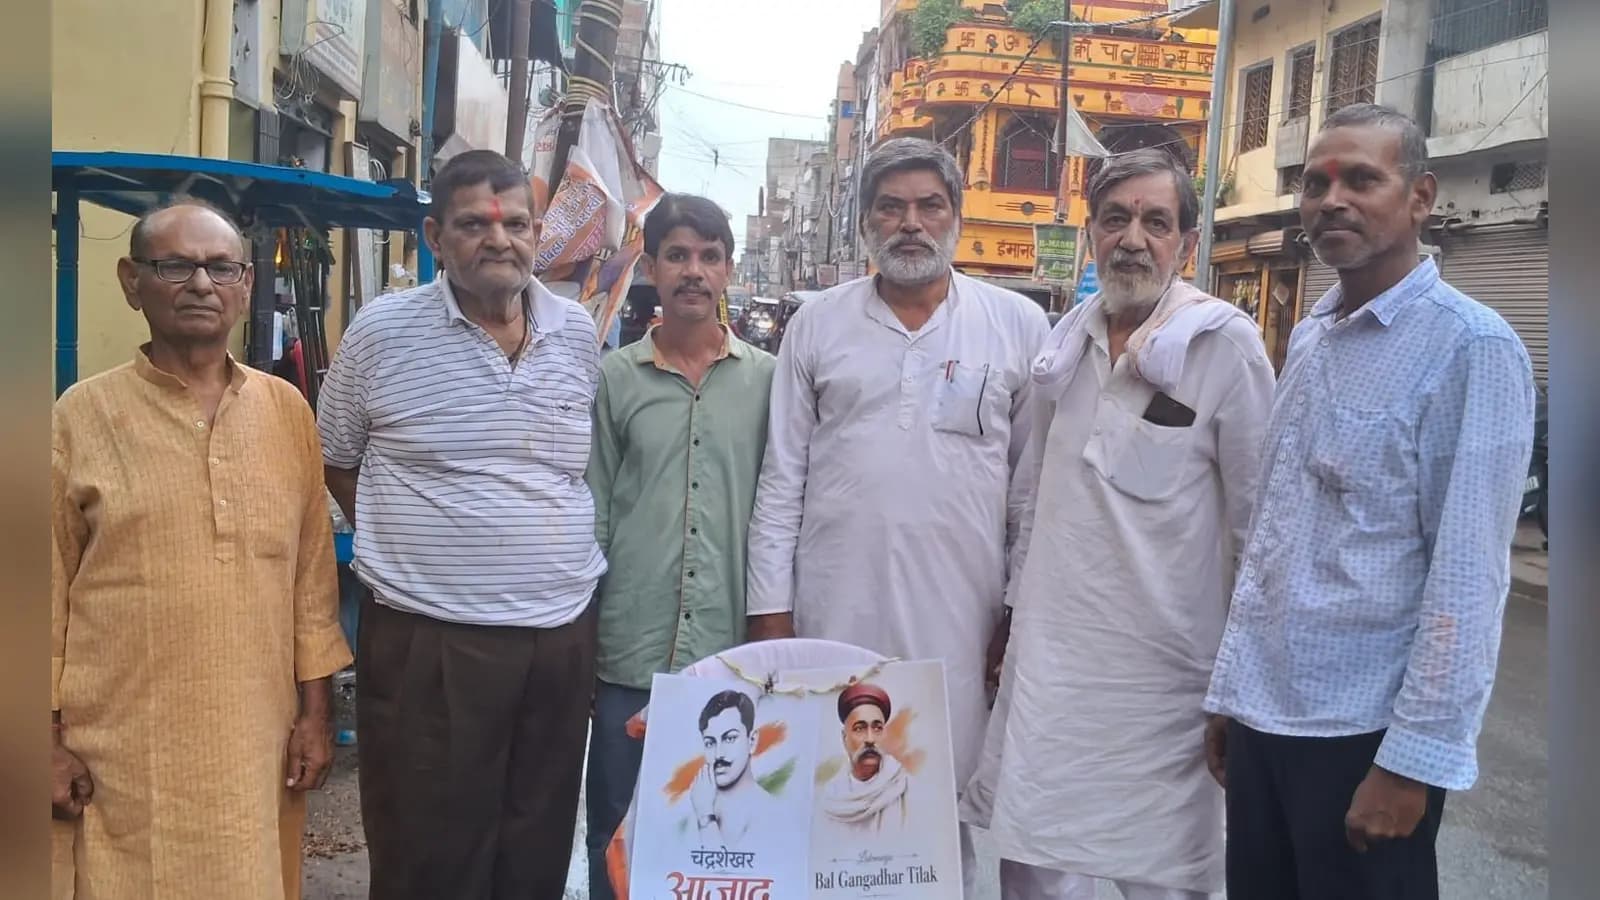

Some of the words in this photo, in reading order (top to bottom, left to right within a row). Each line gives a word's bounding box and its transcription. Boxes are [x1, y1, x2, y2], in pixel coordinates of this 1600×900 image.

[690, 845, 755, 869] चंद्रशेखर
[815, 871, 834, 889] Bal
[838, 867, 905, 891] Gangadhar
[906, 864, 939, 884] Tilak
